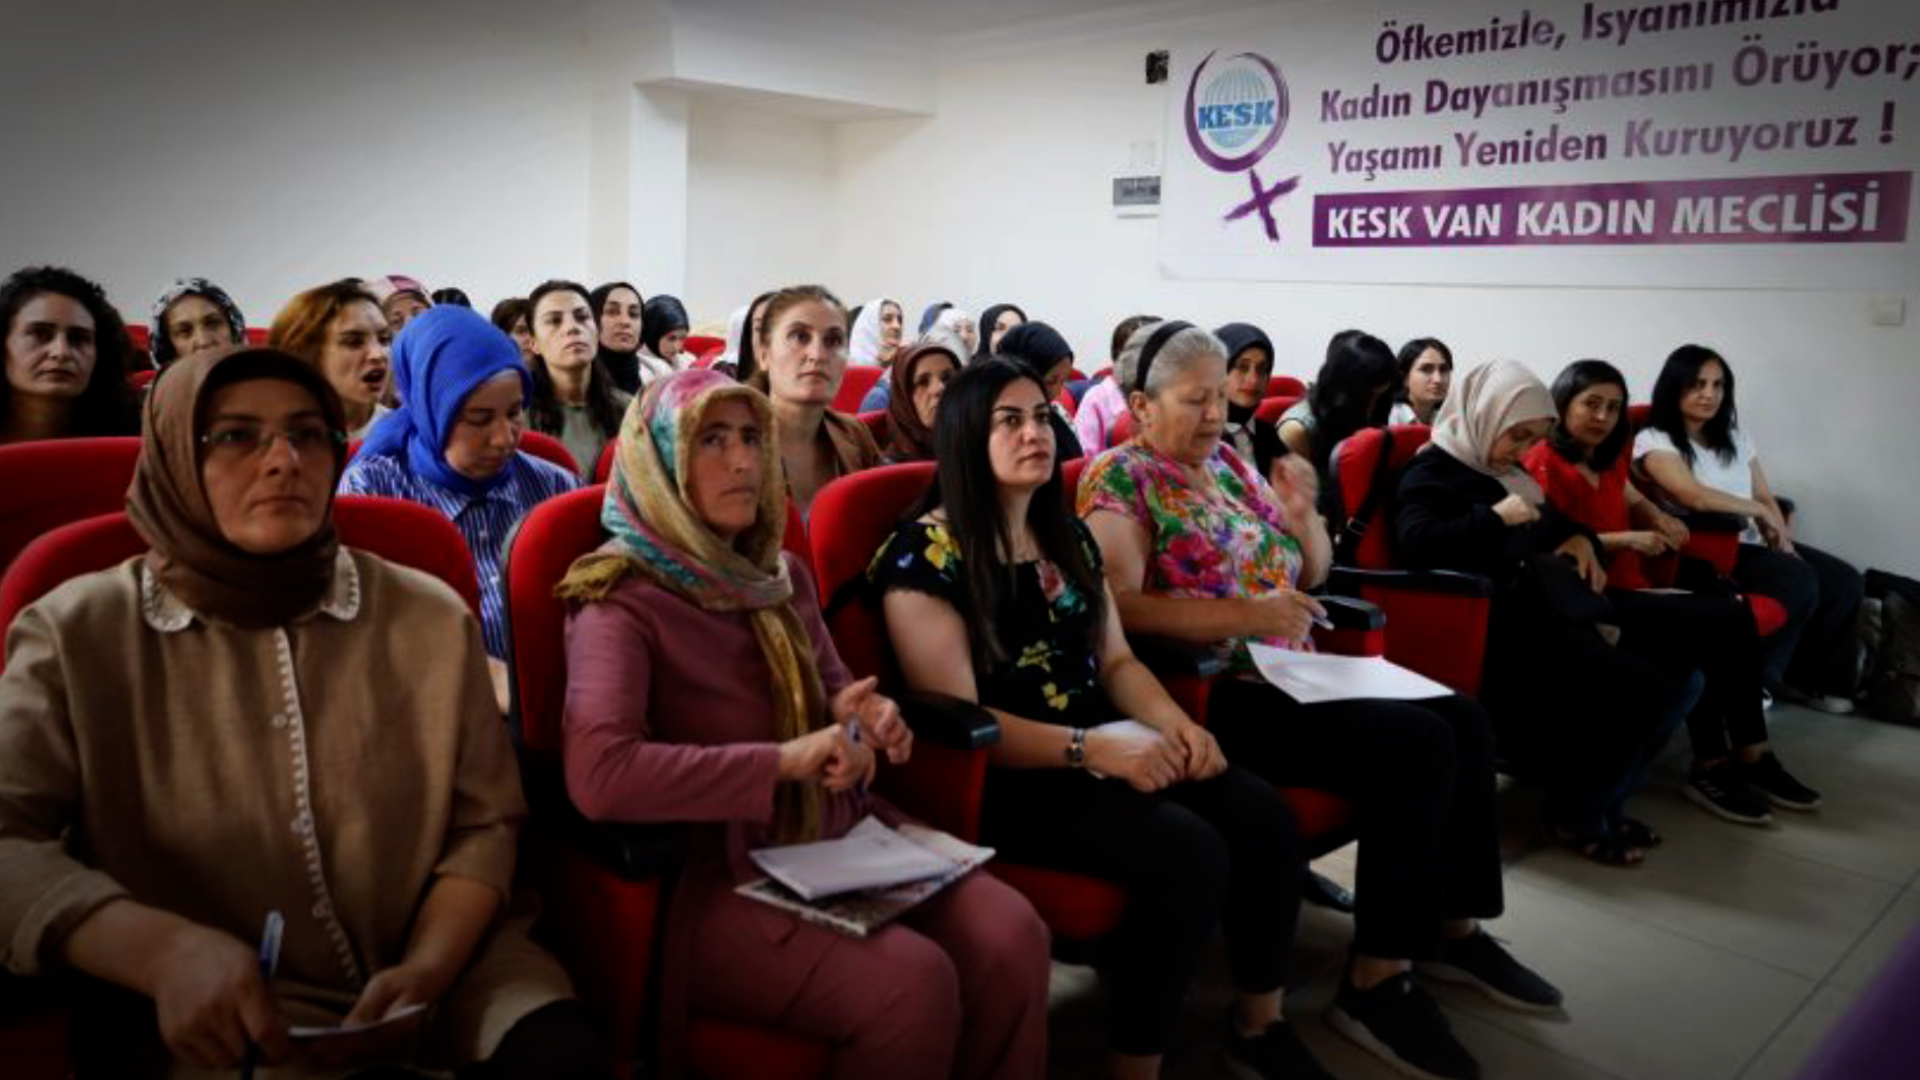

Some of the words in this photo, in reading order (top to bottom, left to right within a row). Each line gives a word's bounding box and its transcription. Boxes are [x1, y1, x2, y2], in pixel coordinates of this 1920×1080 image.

[1376, 11, 1566, 64] Öfkemizle,
[1198, 100, 1275, 130] KESK
[1321, 83, 1412, 122] Kadın
[1424, 63, 1714, 118] Dayanışmasını
[1328, 140, 1442, 181] Yaşamı
[1454, 124, 1608, 167] Yeniden
[1624, 116, 1858, 163] Kuruyoruz
[1879, 101, 1895, 144] !
[1328, 206, 1412, 238] KESK
[1423, 203, 1501, 238] VAN
[1516, 199, 1655, 237] KADIN
[1671, 180, 1879, 234] MECLİSİ
